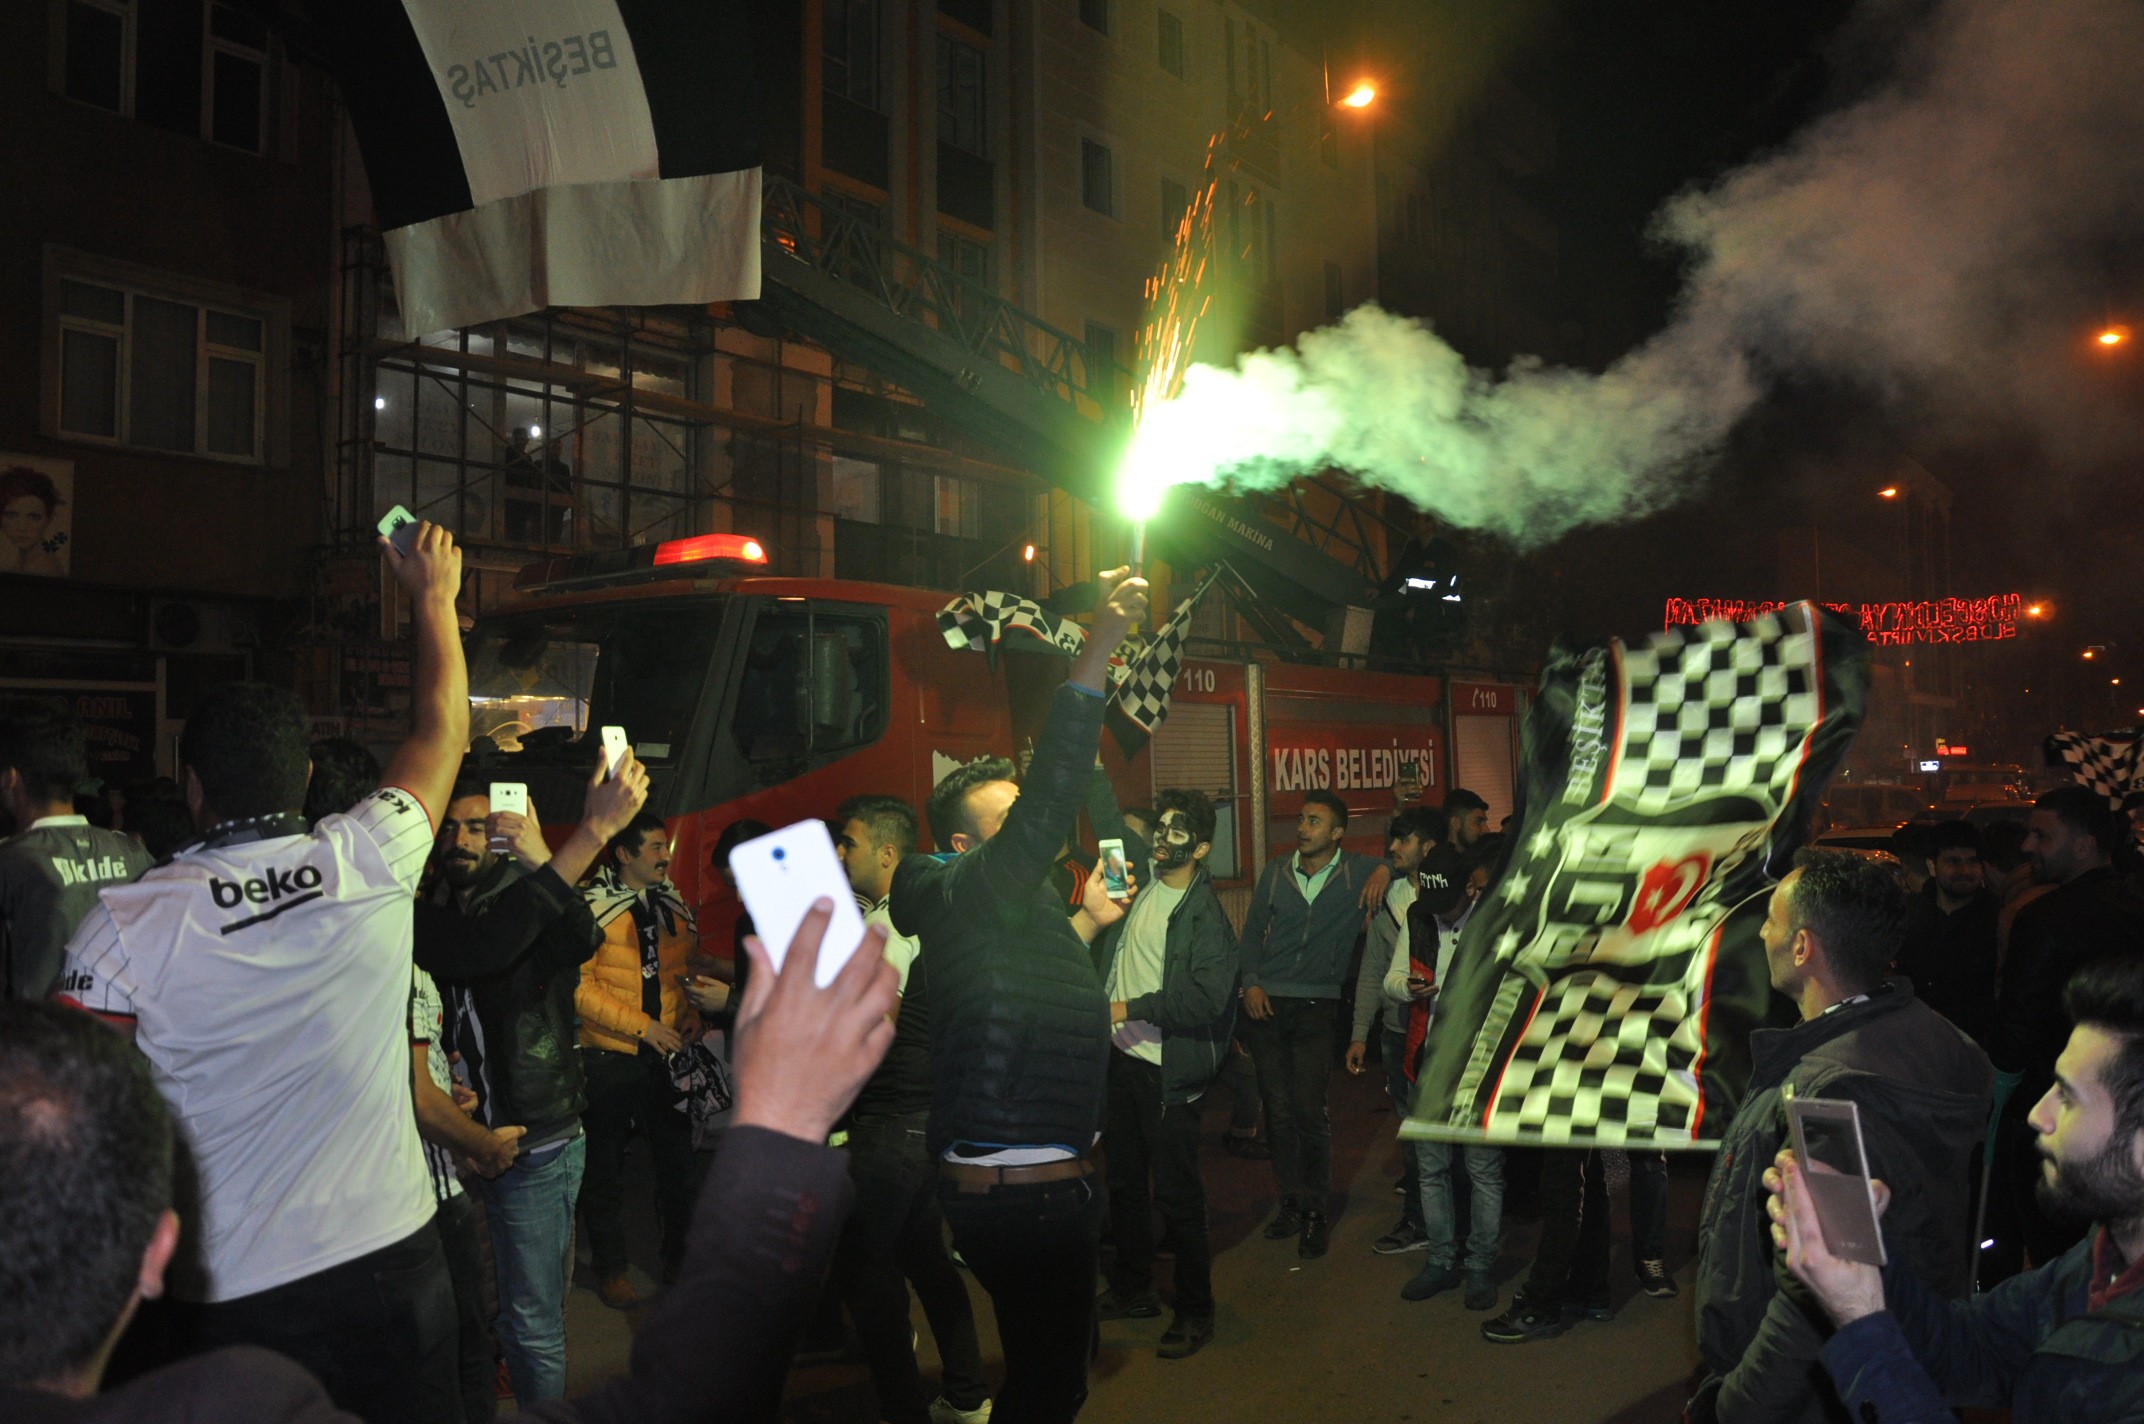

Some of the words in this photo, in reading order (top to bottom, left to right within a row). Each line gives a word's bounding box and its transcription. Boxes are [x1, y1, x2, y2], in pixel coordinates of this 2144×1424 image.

[1226, 516, 1274, 552] MAKİNA
[1183, 668, 1216, 692] 110
[1479, 691, 1498, 709] 110
[1274, 748, 1330, 791] KARS
[209, 864, 322, 909] beko
